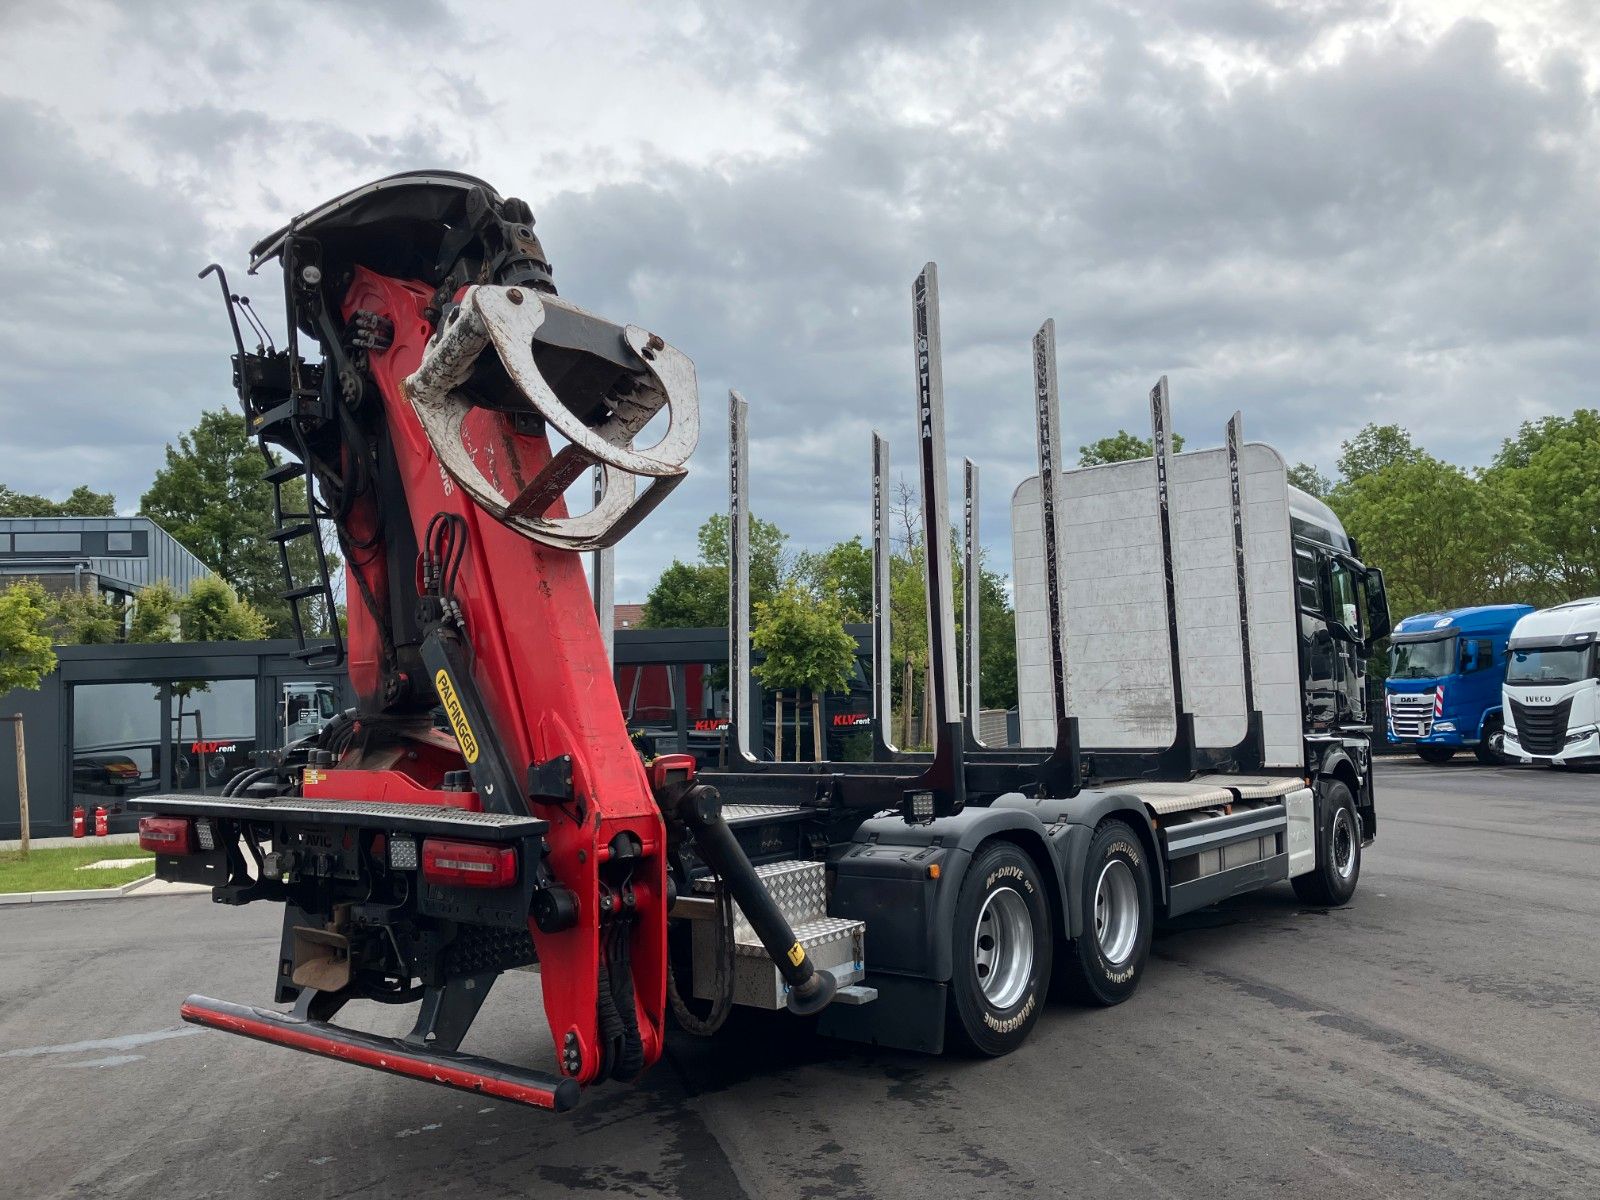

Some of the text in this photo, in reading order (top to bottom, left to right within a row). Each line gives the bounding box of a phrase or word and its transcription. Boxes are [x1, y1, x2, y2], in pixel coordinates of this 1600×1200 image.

[918, 339, 931, 439] OPTIPA
[1525, 695, 1552, 703] IVECO
[437, 674, 476, 759] PALFINGER
[191, 741, 237, 753] KLV.rent
[986, 865, 1024, 890] M-DRIVE
[1105, 964, 1135, 984] M-DRIVE
[983, 993, 1036, 1034] BRIDGESTONE
